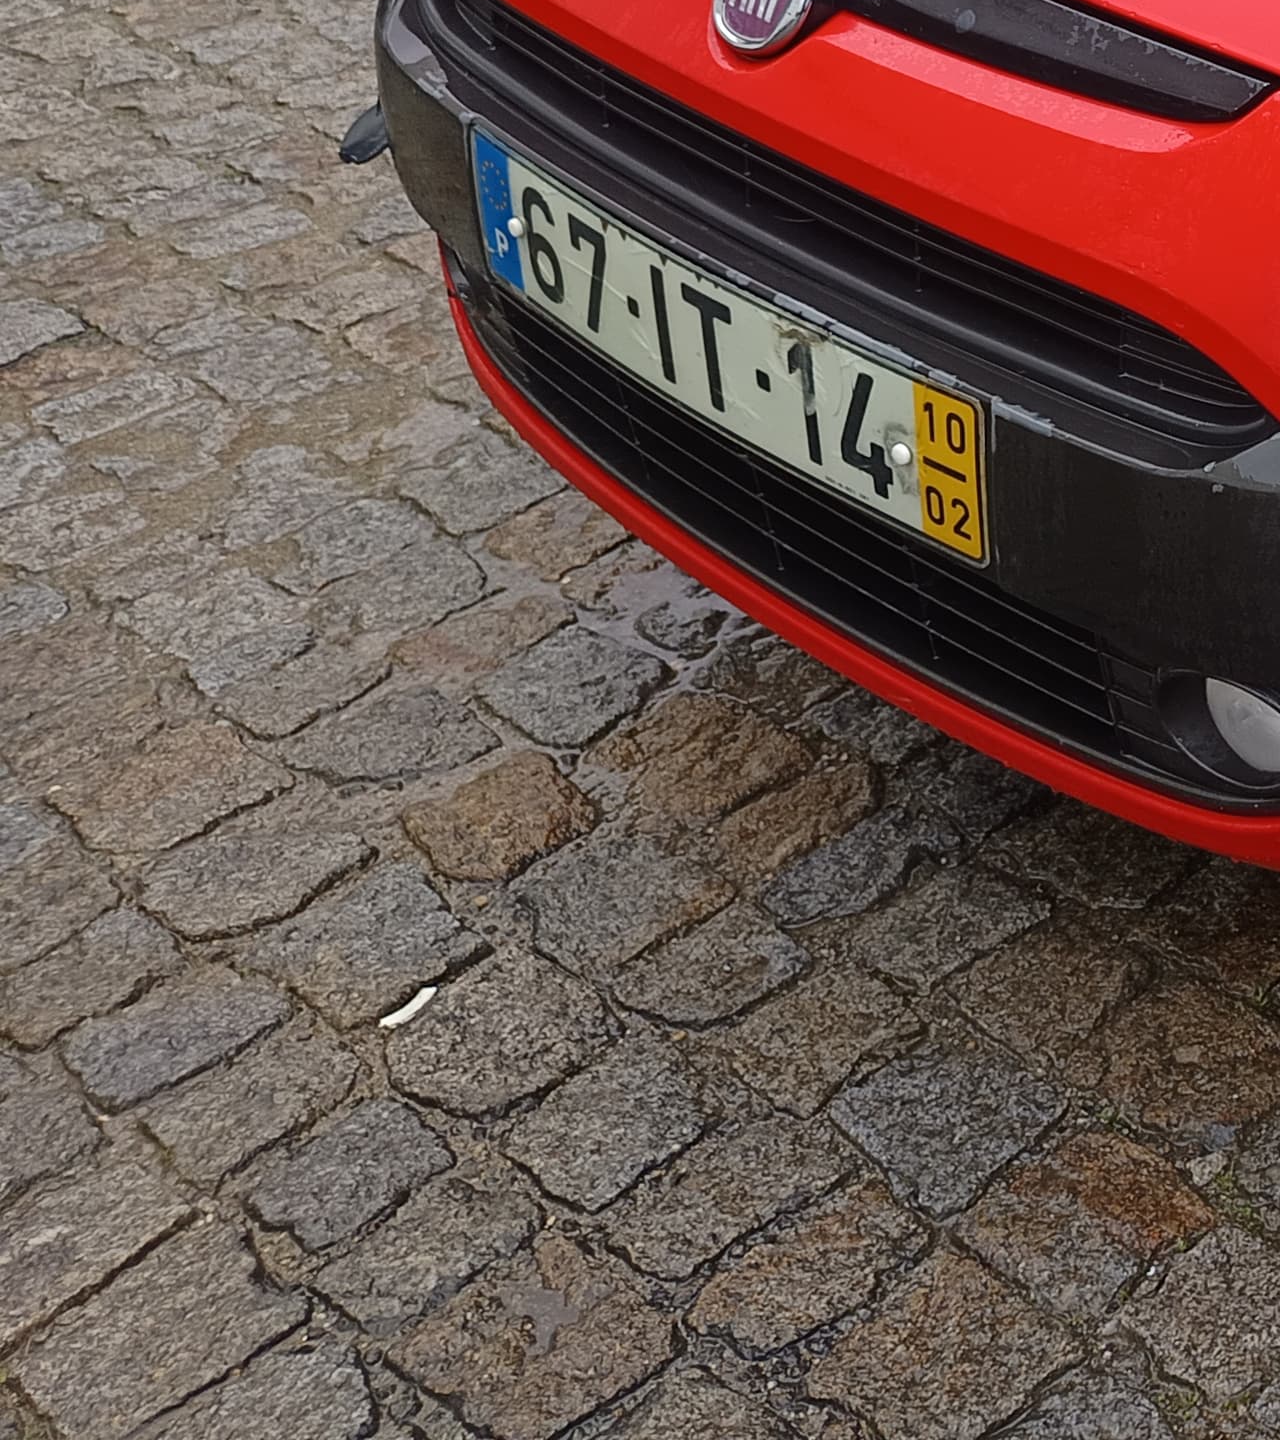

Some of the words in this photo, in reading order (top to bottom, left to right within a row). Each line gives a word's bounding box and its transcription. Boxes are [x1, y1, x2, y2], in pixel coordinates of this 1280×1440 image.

[493, 227, 510, 259] P
[922, 401, 966, 455] 10
[925, 485, 972, 541] 02
